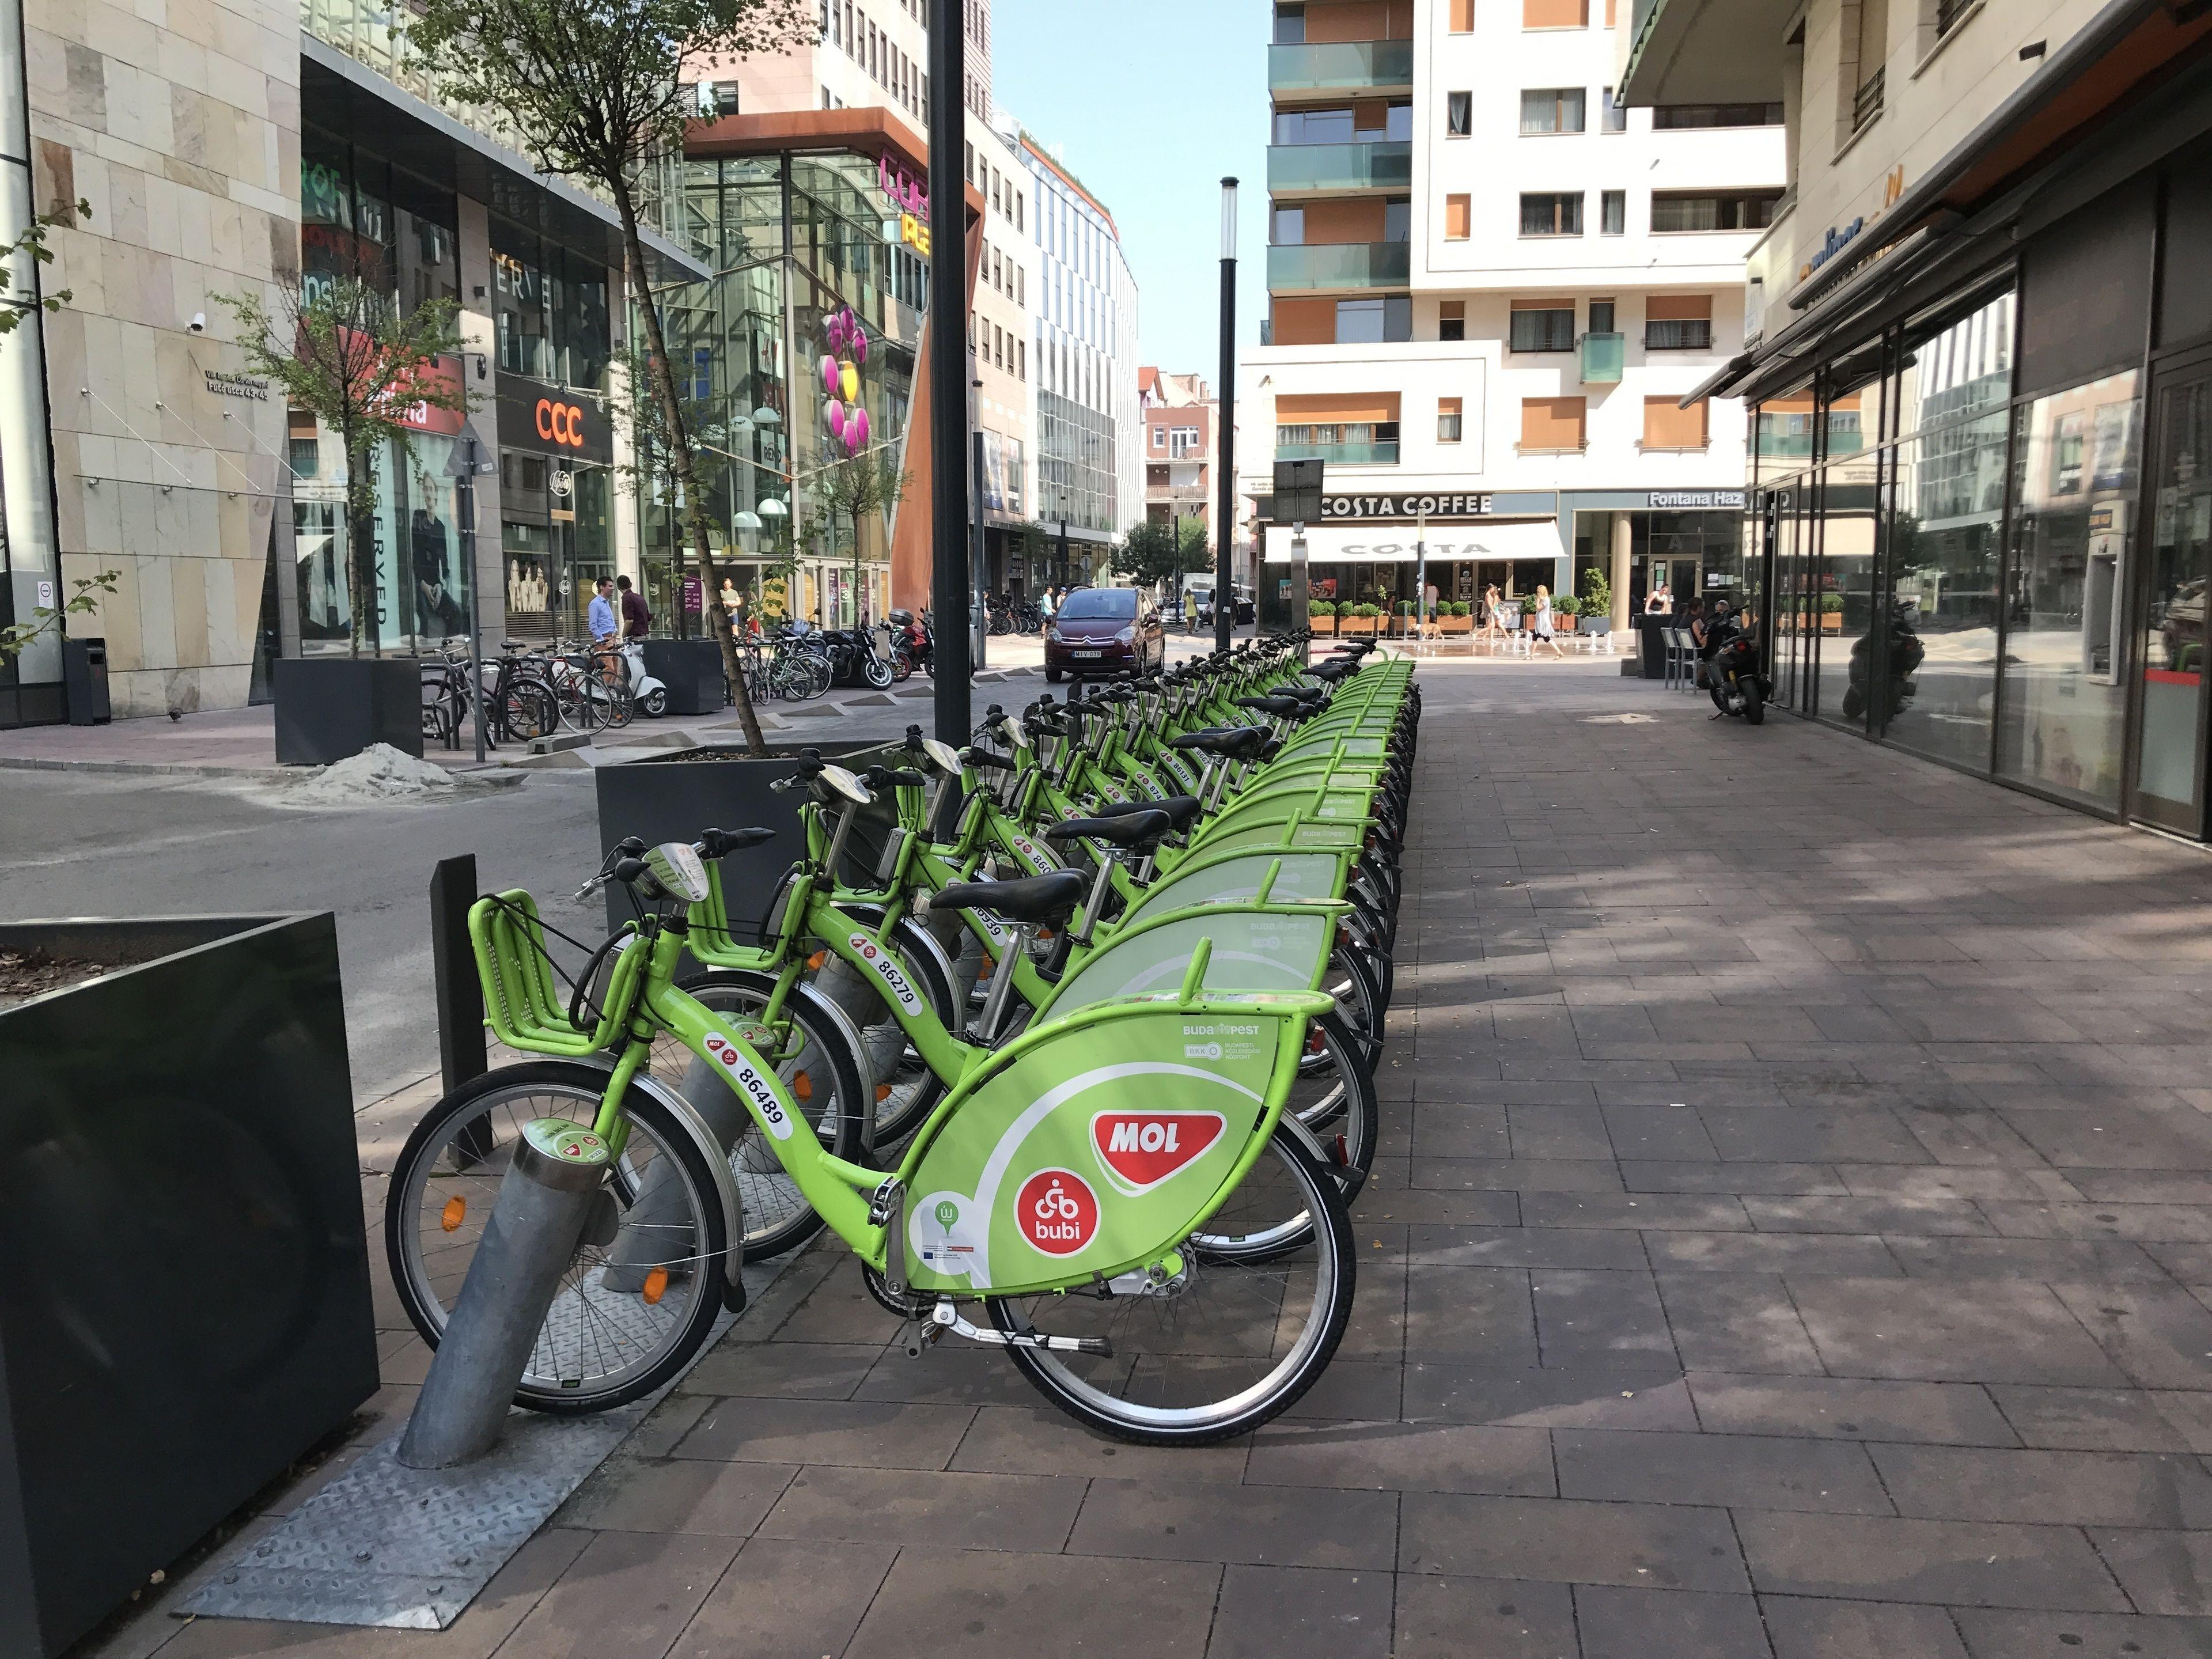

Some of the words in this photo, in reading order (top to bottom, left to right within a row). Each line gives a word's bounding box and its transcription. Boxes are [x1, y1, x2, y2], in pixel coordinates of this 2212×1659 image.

[536, 398, 582, 447] CCC
[1321, 497, 1395, 517] COSTA
[1402, 495, 1493, 515] COFFEE
[1650, 491, 1710, 505] Fontana
[1340, 543, 1492, 555] COSTA
[1173, 763, 1190, 782] 86131
[878, 961, 914, 1003] 86279
[739, 1069, 783, 1124] 86489
[1108, 1122, 1180, 1153] MOL
[1035, 1221, 1080, 1240] bubi
